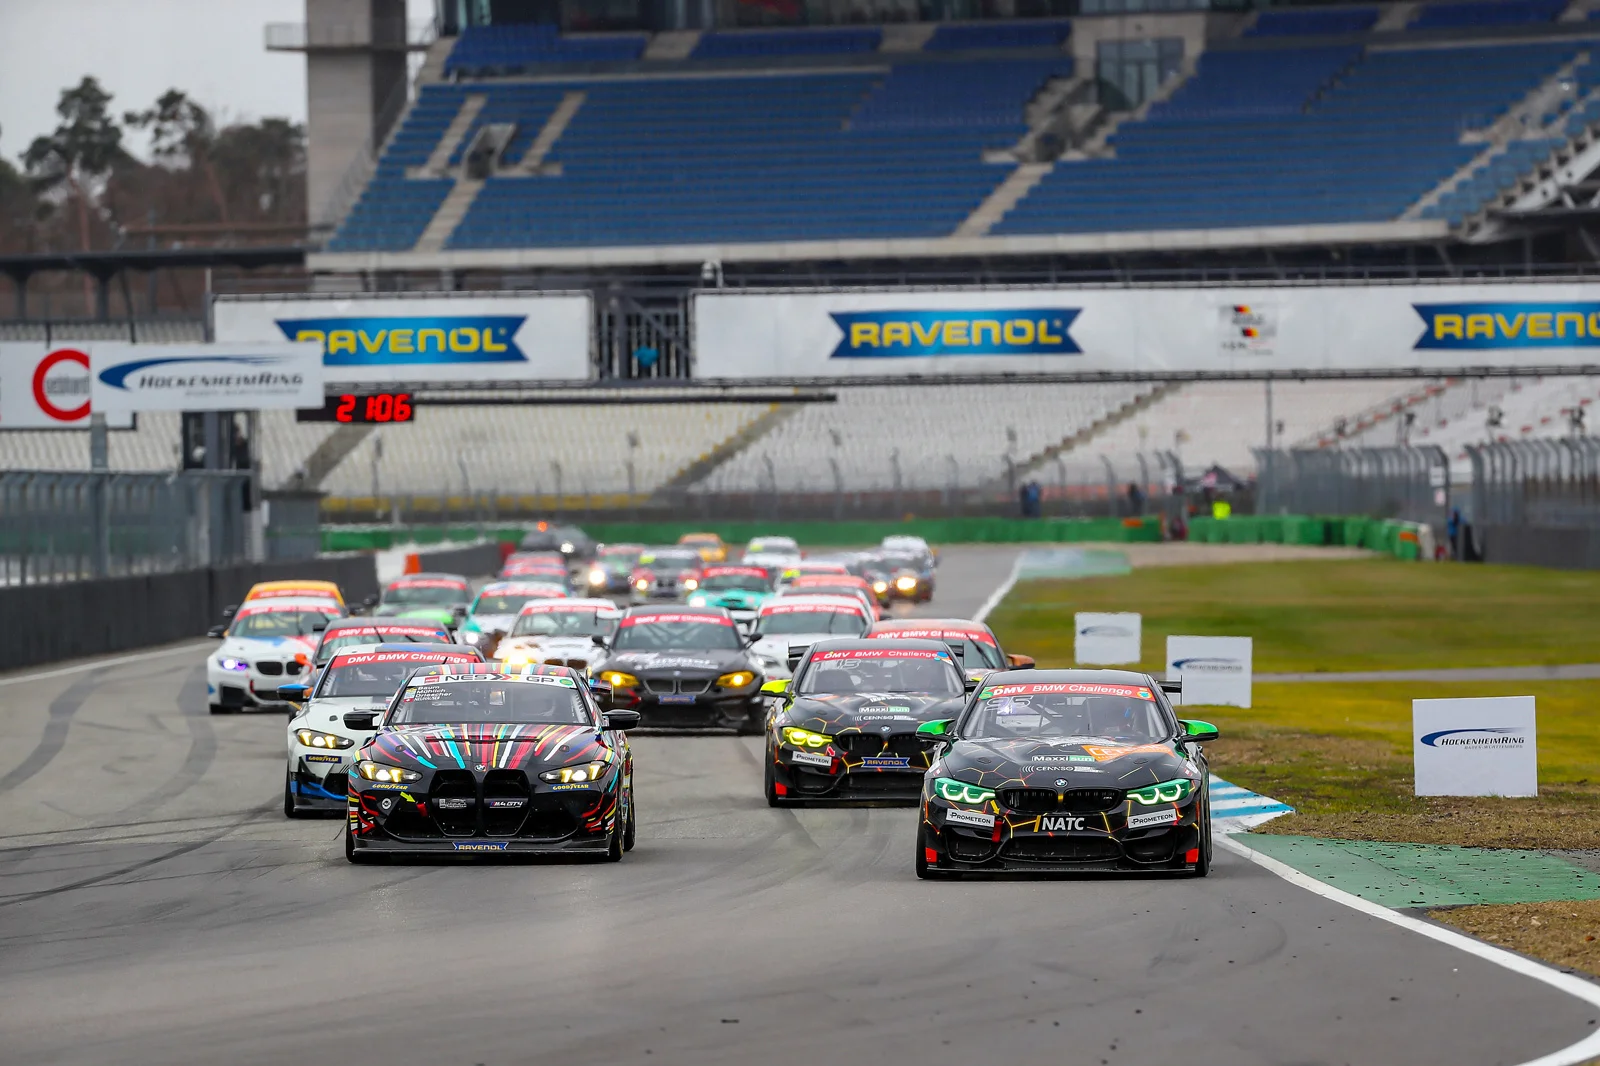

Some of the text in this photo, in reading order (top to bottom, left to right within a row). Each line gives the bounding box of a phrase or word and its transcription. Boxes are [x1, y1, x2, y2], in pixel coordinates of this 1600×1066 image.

[850, 318, 1063, 348] RAVENOL
[338, 626, 436, 637] DMV BMW Challenge
[876, 632, 900, 640] DMV
[347, 652, 468, 664] DMV BMW Challenge
[824, 651, 851, 659] DMV
[888, 650, 938, 658] Challenge
[445, 674, 487, 682] NES
[526, 675, 554, 683] GP
[993, 684, 1133, 696] DMV BMW Challenge
[308, 754, 339, 763] GOODYEAR
[950, 811, 991, 824] PROMETEON
[1041, 816, 1085, 831] NATC
[1131, 813, 1174, 825] PROMETEON
